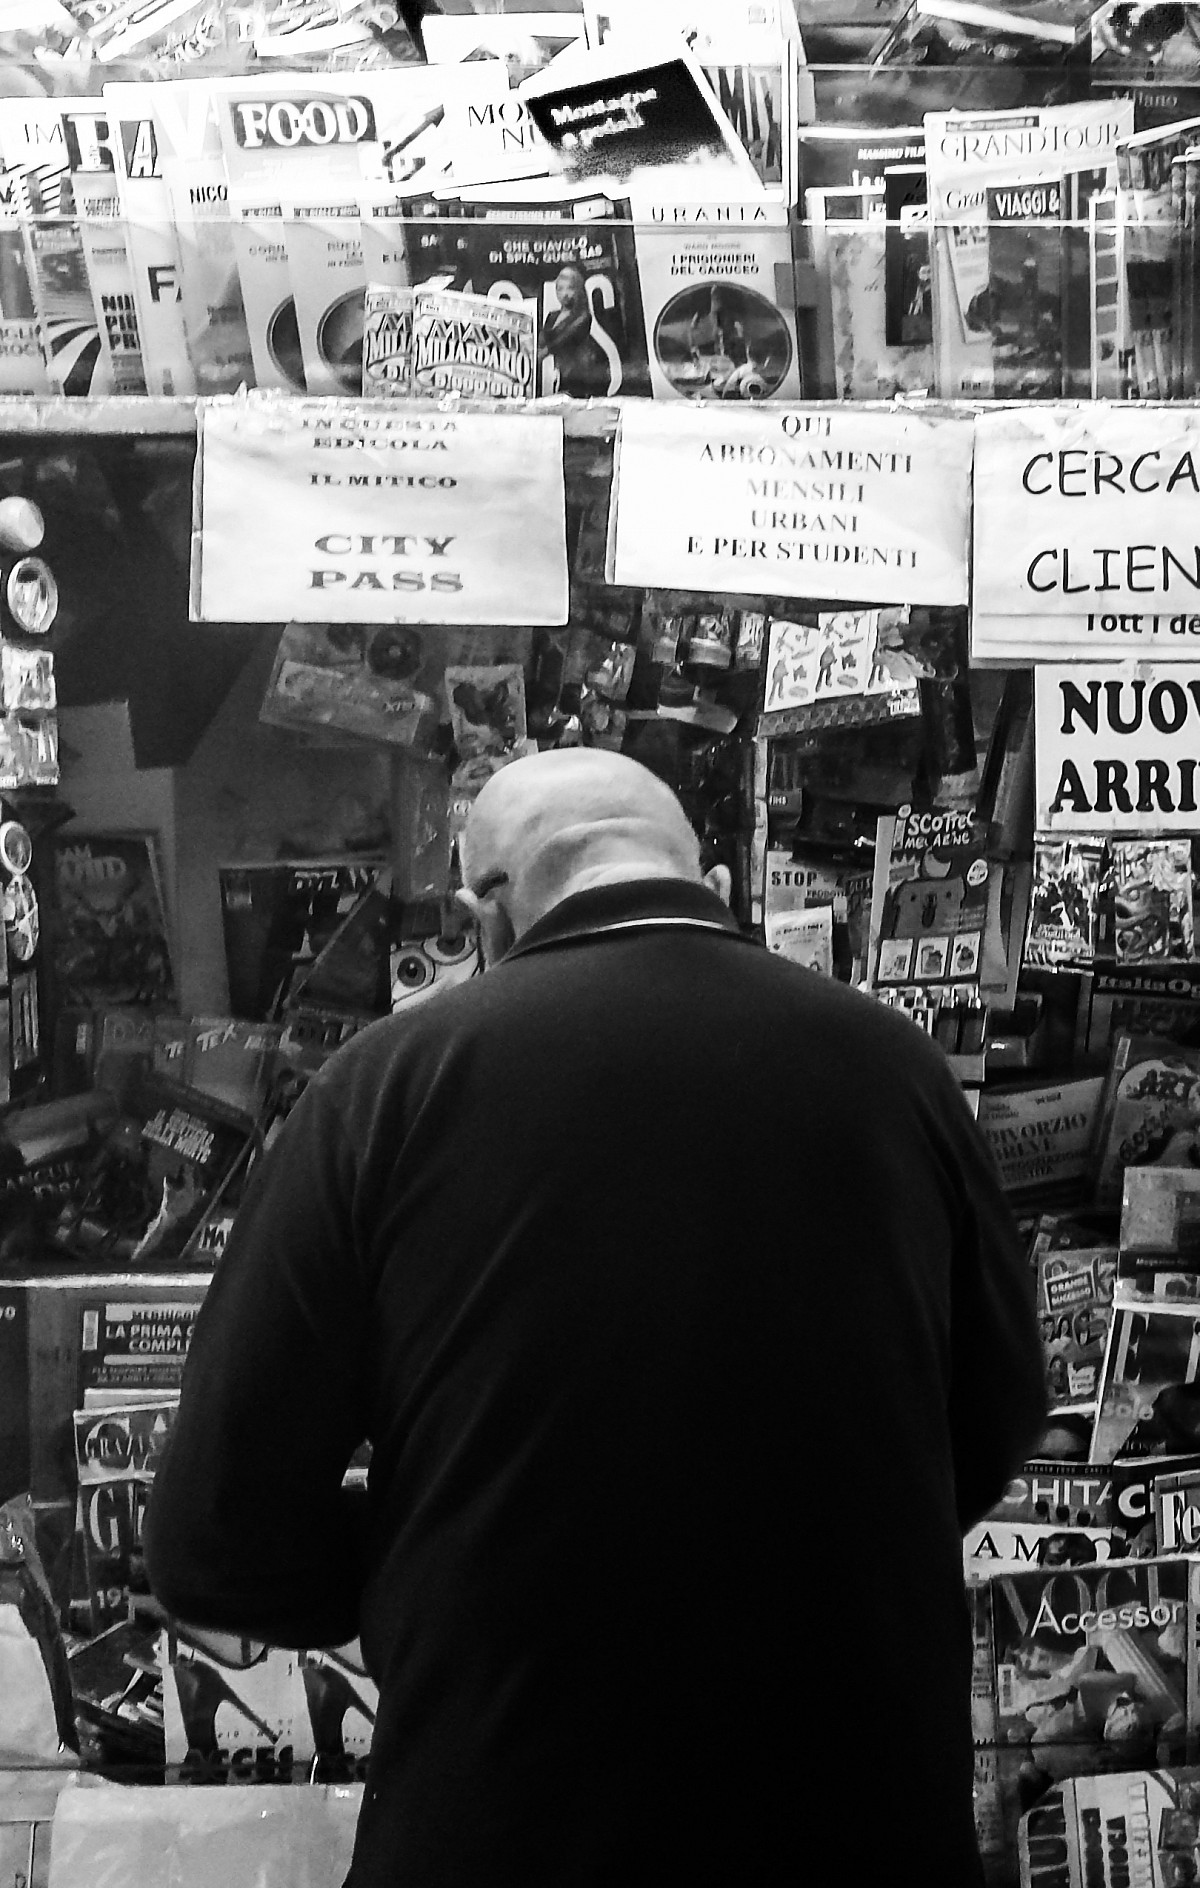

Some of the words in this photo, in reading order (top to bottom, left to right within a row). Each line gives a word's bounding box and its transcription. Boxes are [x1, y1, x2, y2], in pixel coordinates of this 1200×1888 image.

[236, 101, 369, 149] FOOD
[651, 206, 767, 223] URANIA
[995, 189, 1047, 217] VIAGGI
[781, 415, 832, 440] QUI
[313, 437, 449, 451] EDICOLA
[699, 443, 913, 474] ABBONAMENTI
[310, 474, 341, 486] IL
[348, 475, 458, 489] MITICO
[746, 477, 865, 504] MENSILI
[751, 509, 859, 533] URBANI
[314, 534, 456, 556] CITY
[687, 535, 704, 555] E
[714, 537, 768, 560] PER
[777, 541, 918, 569] STUDENTI
[308, 570, 464, 593] PASS
[771, 870, 818, 888] STOP
[105, 1324, 126, 1339] LA
[130, 1324, 182, 1338] PRIMA
